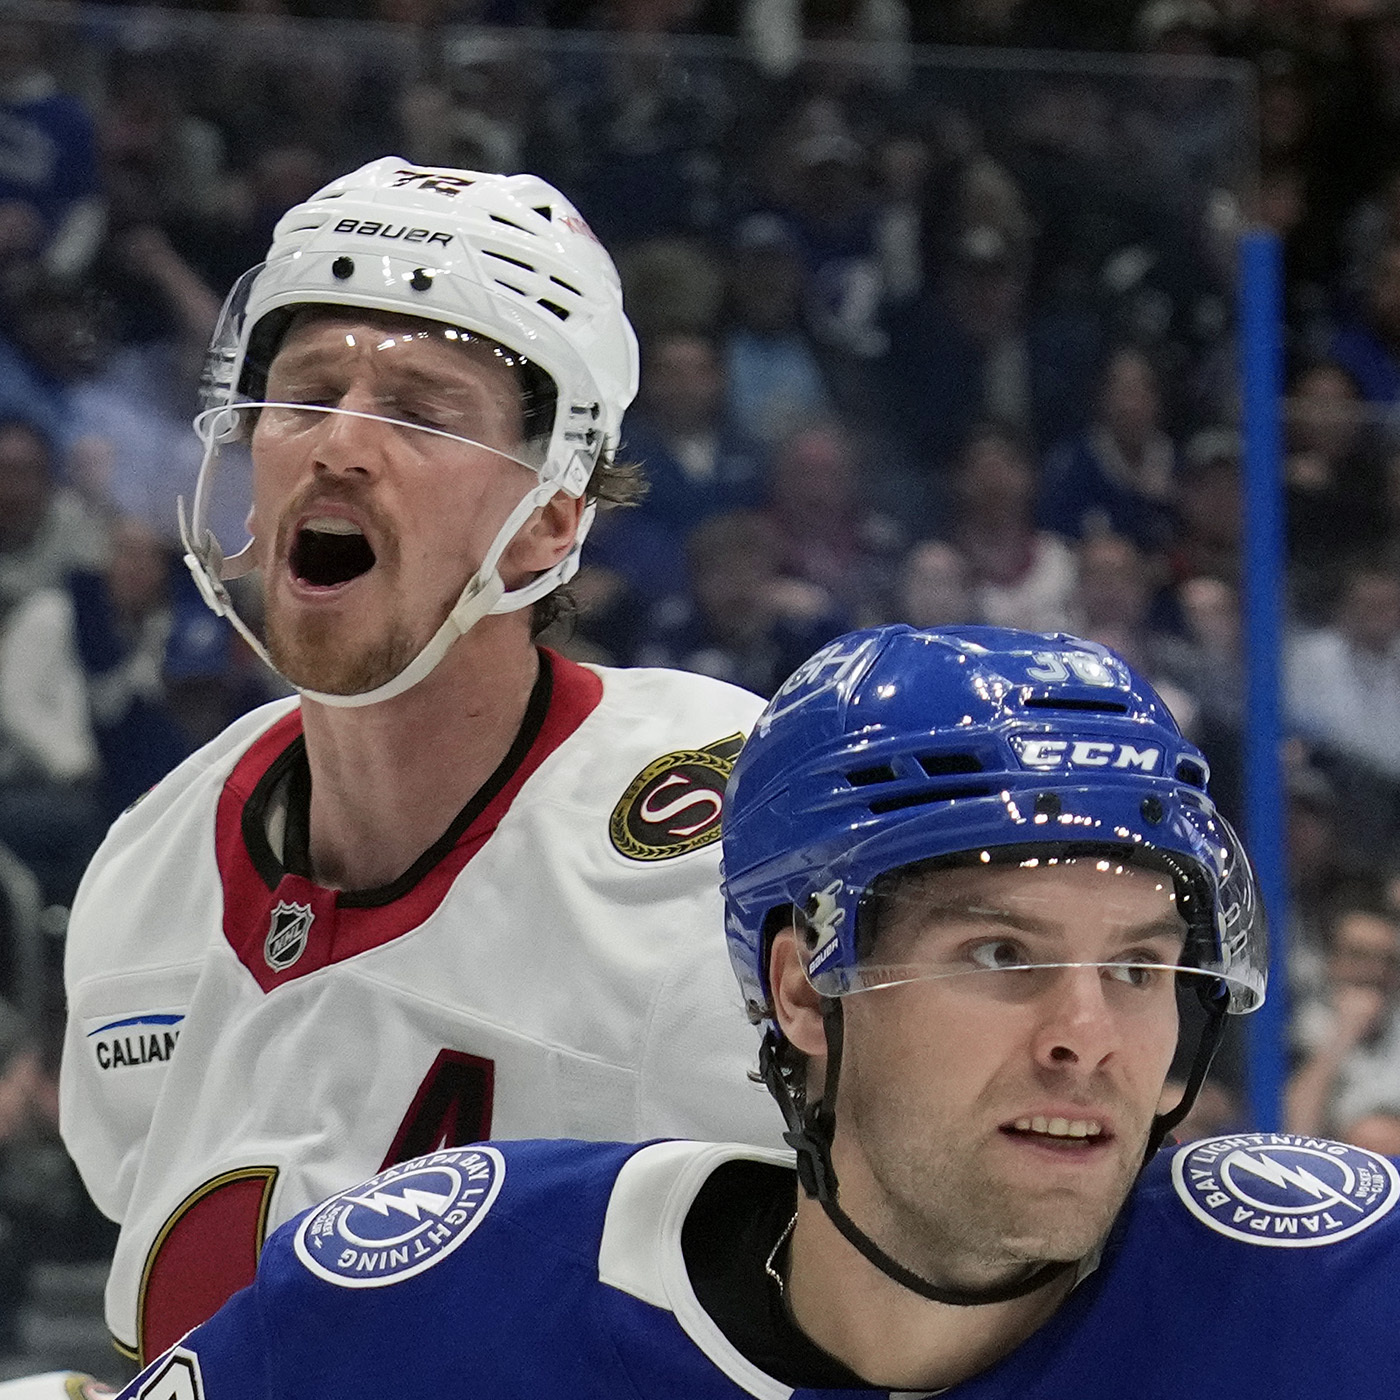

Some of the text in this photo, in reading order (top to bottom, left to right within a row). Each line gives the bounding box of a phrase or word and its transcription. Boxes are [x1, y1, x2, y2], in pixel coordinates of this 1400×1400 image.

[333, 218, 454, 248] BAUER
[1021, 741, 1161, 772] CCM
[377, 1047, 495, 1174] A
[337, 1152, 490, 1272] TAMPA BAY LIGHTNING
[1190, 1136, 1350, 1234] TAMPA BAY LIGHTNING
